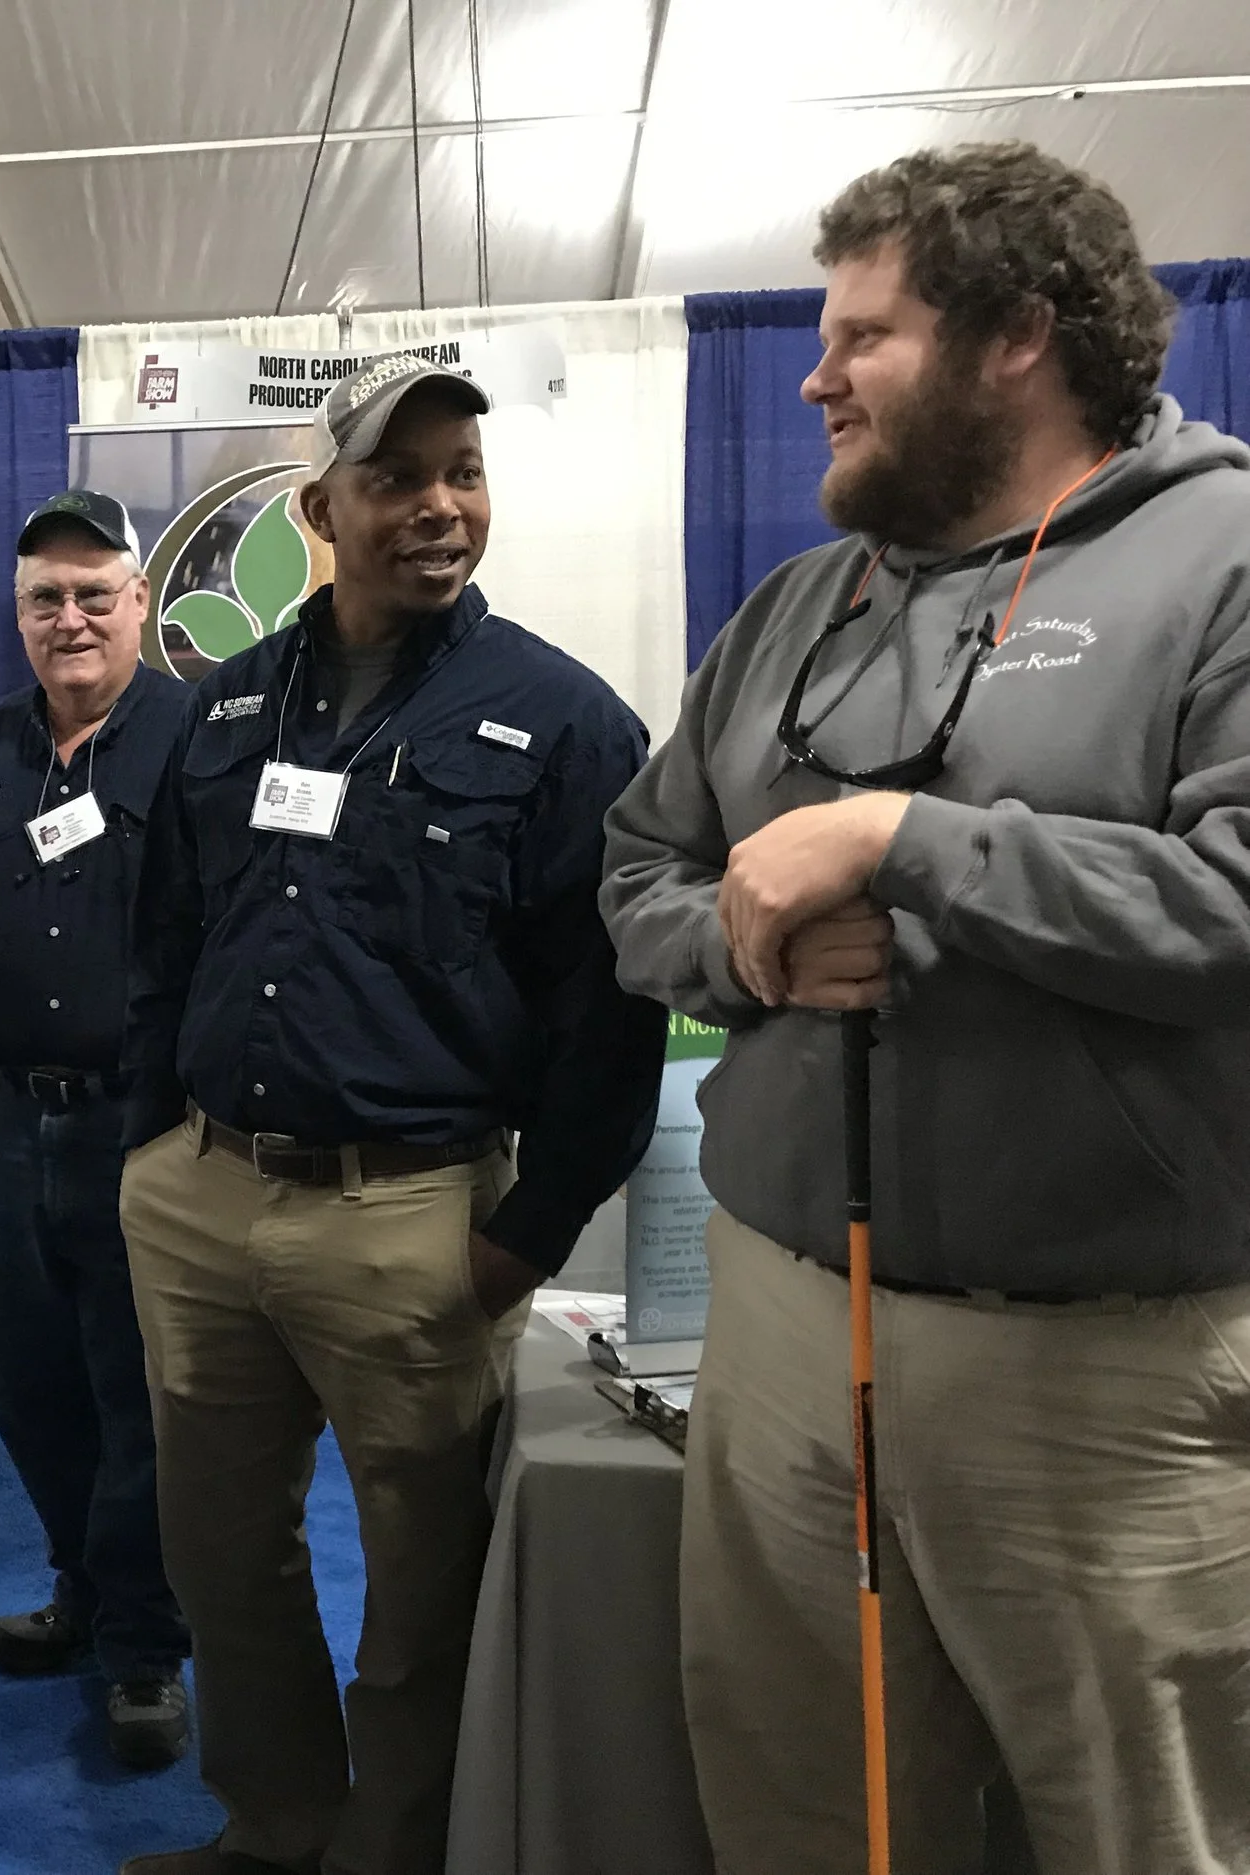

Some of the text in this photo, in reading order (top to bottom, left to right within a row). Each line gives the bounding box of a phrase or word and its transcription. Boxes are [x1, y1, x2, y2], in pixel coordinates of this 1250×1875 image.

[259, 341, 461, 380] NORTH CAROL YBEAN
[147, 376, 176, 389] FARM
[144, 388, 175, 401] SHOW
[1019, 615, 1099, 647] Saturday
[1025, 652, 1083, 671] Roast
[683, 1013, 729, 1035] NO
